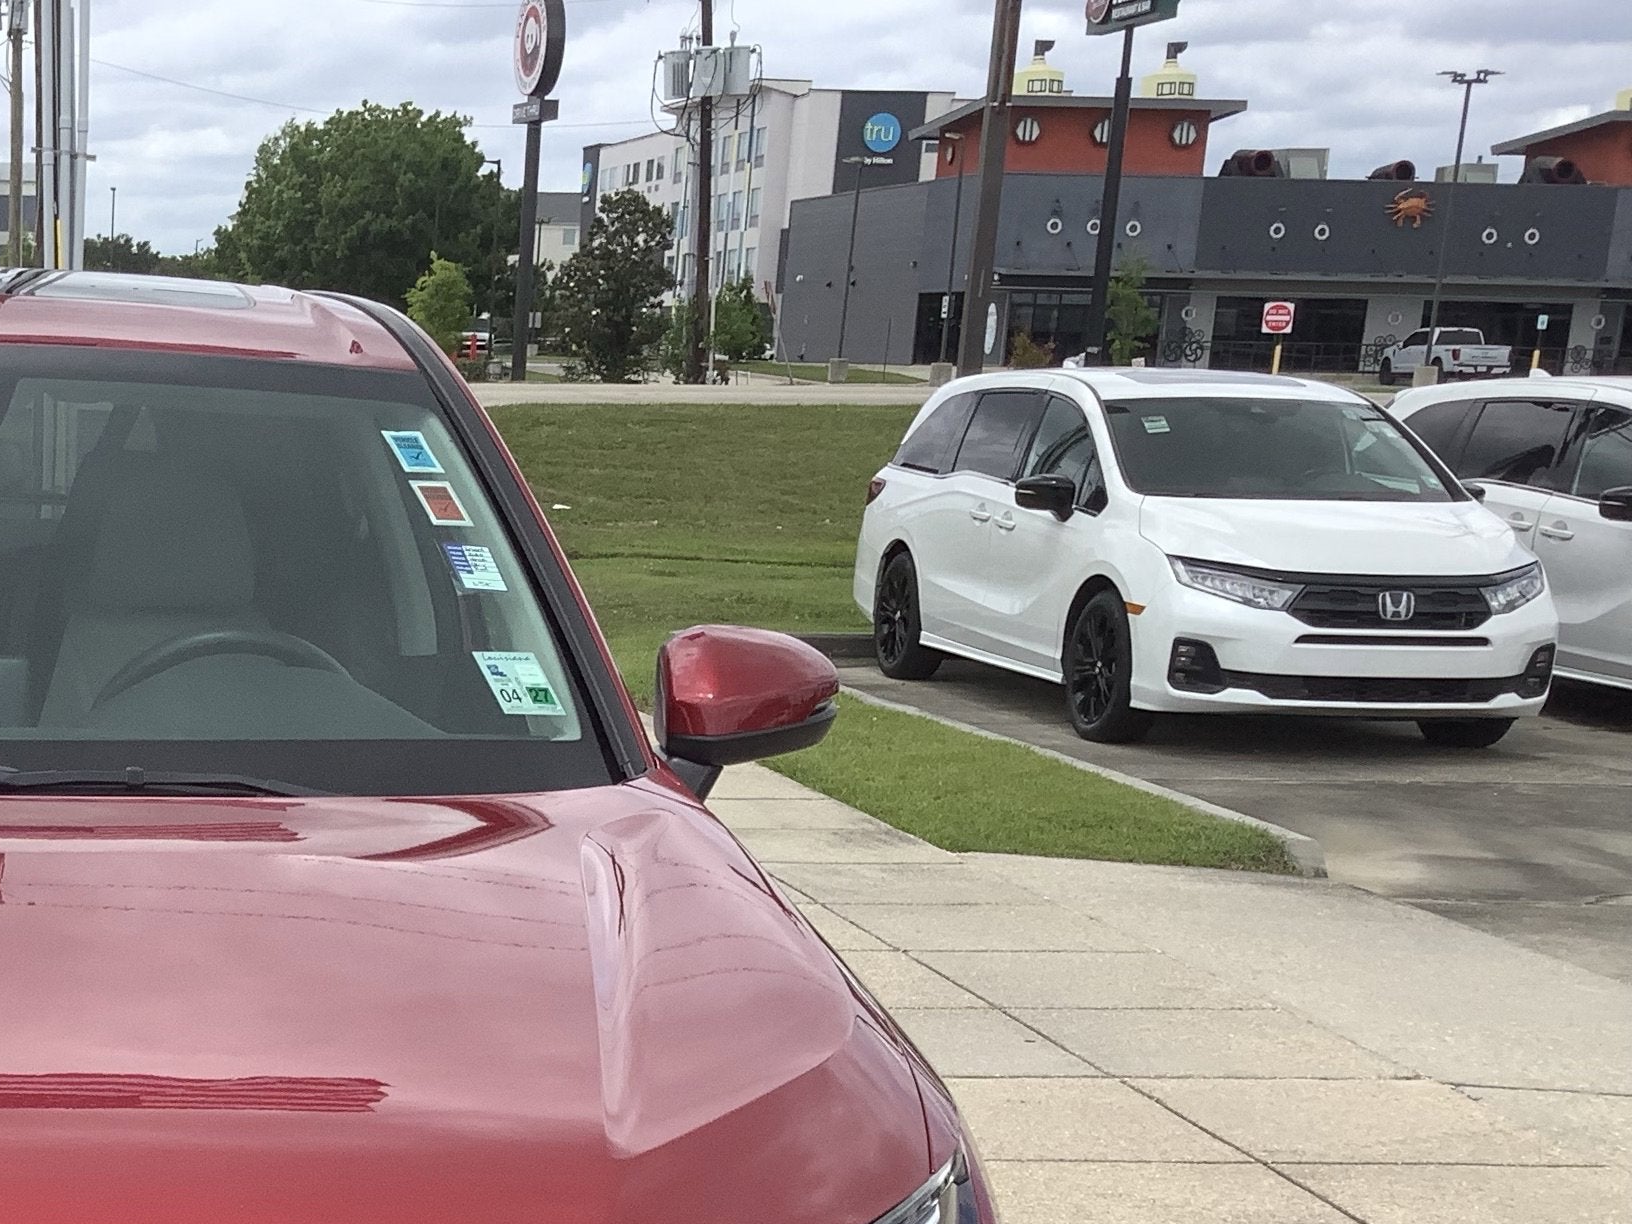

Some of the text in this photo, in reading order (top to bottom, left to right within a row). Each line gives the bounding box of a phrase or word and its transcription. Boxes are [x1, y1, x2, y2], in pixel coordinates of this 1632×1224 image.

[864, 122, 894, 141] tru
[499, 687, 550, 703] 04 27
